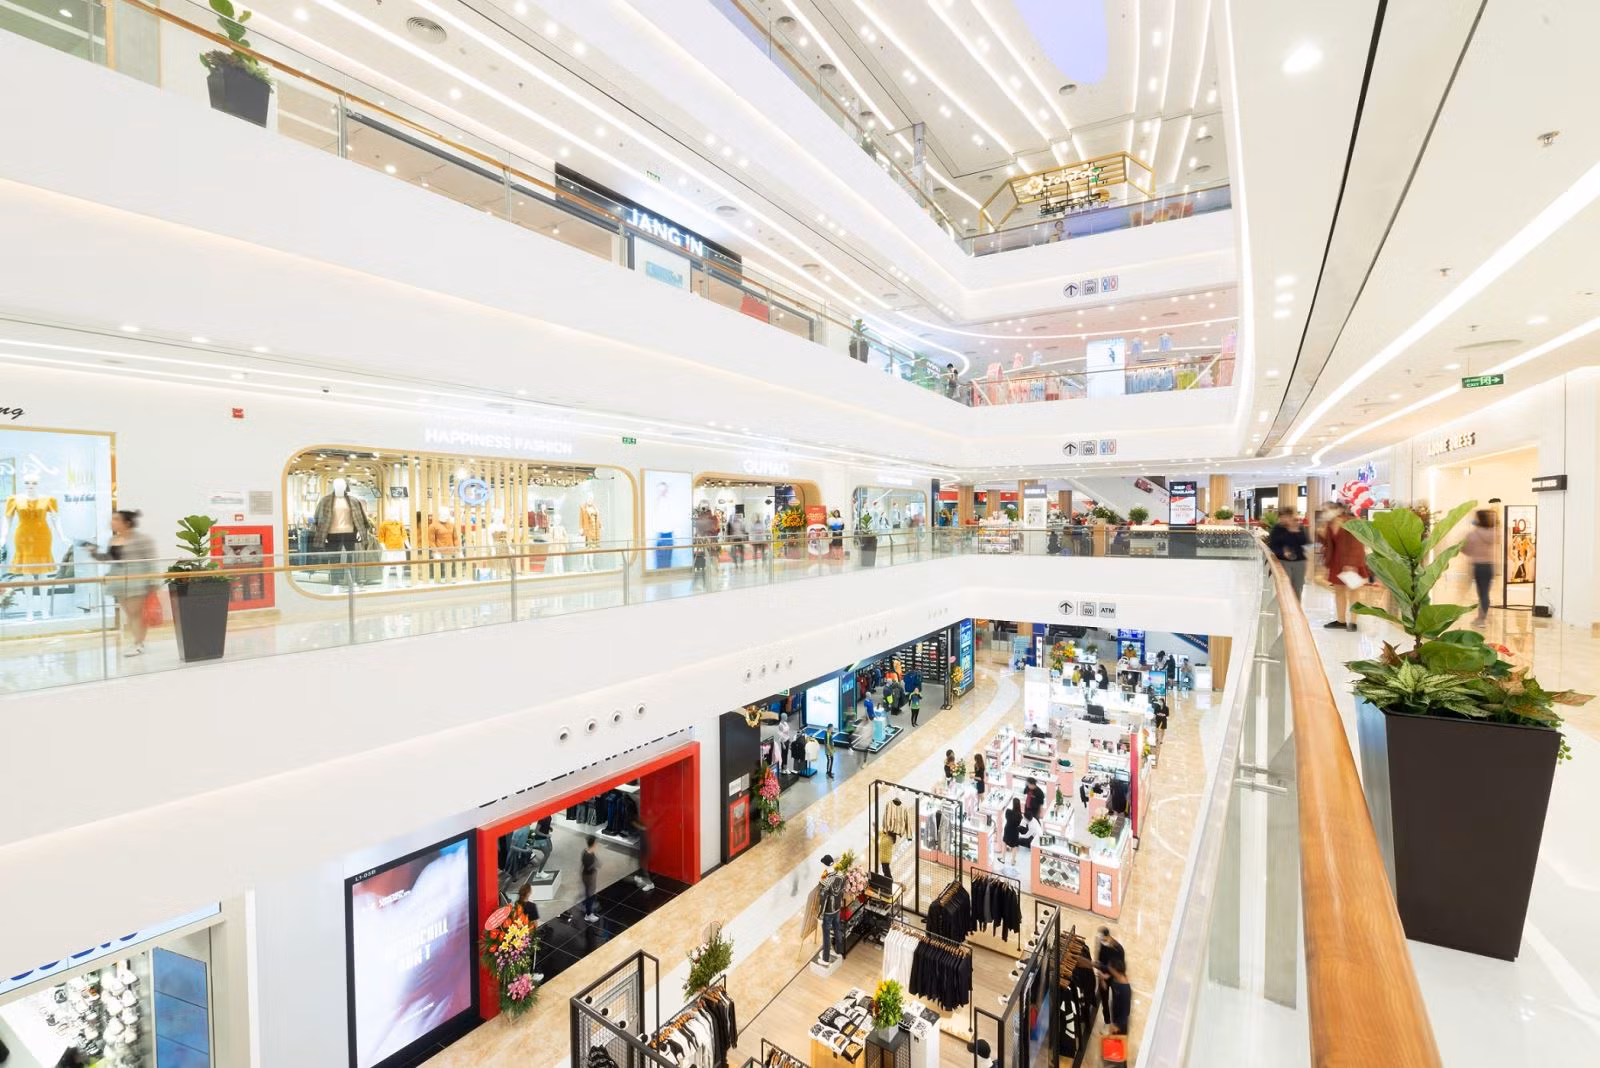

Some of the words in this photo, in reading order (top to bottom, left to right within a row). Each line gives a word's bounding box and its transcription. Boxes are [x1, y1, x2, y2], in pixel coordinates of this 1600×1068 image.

[626, 208, 682, 247] JANG
[685, 234, 704, 257] IN
[425, 428, 512, 449] HAPPINESS
[514, 437, 573, 456] FASHION
